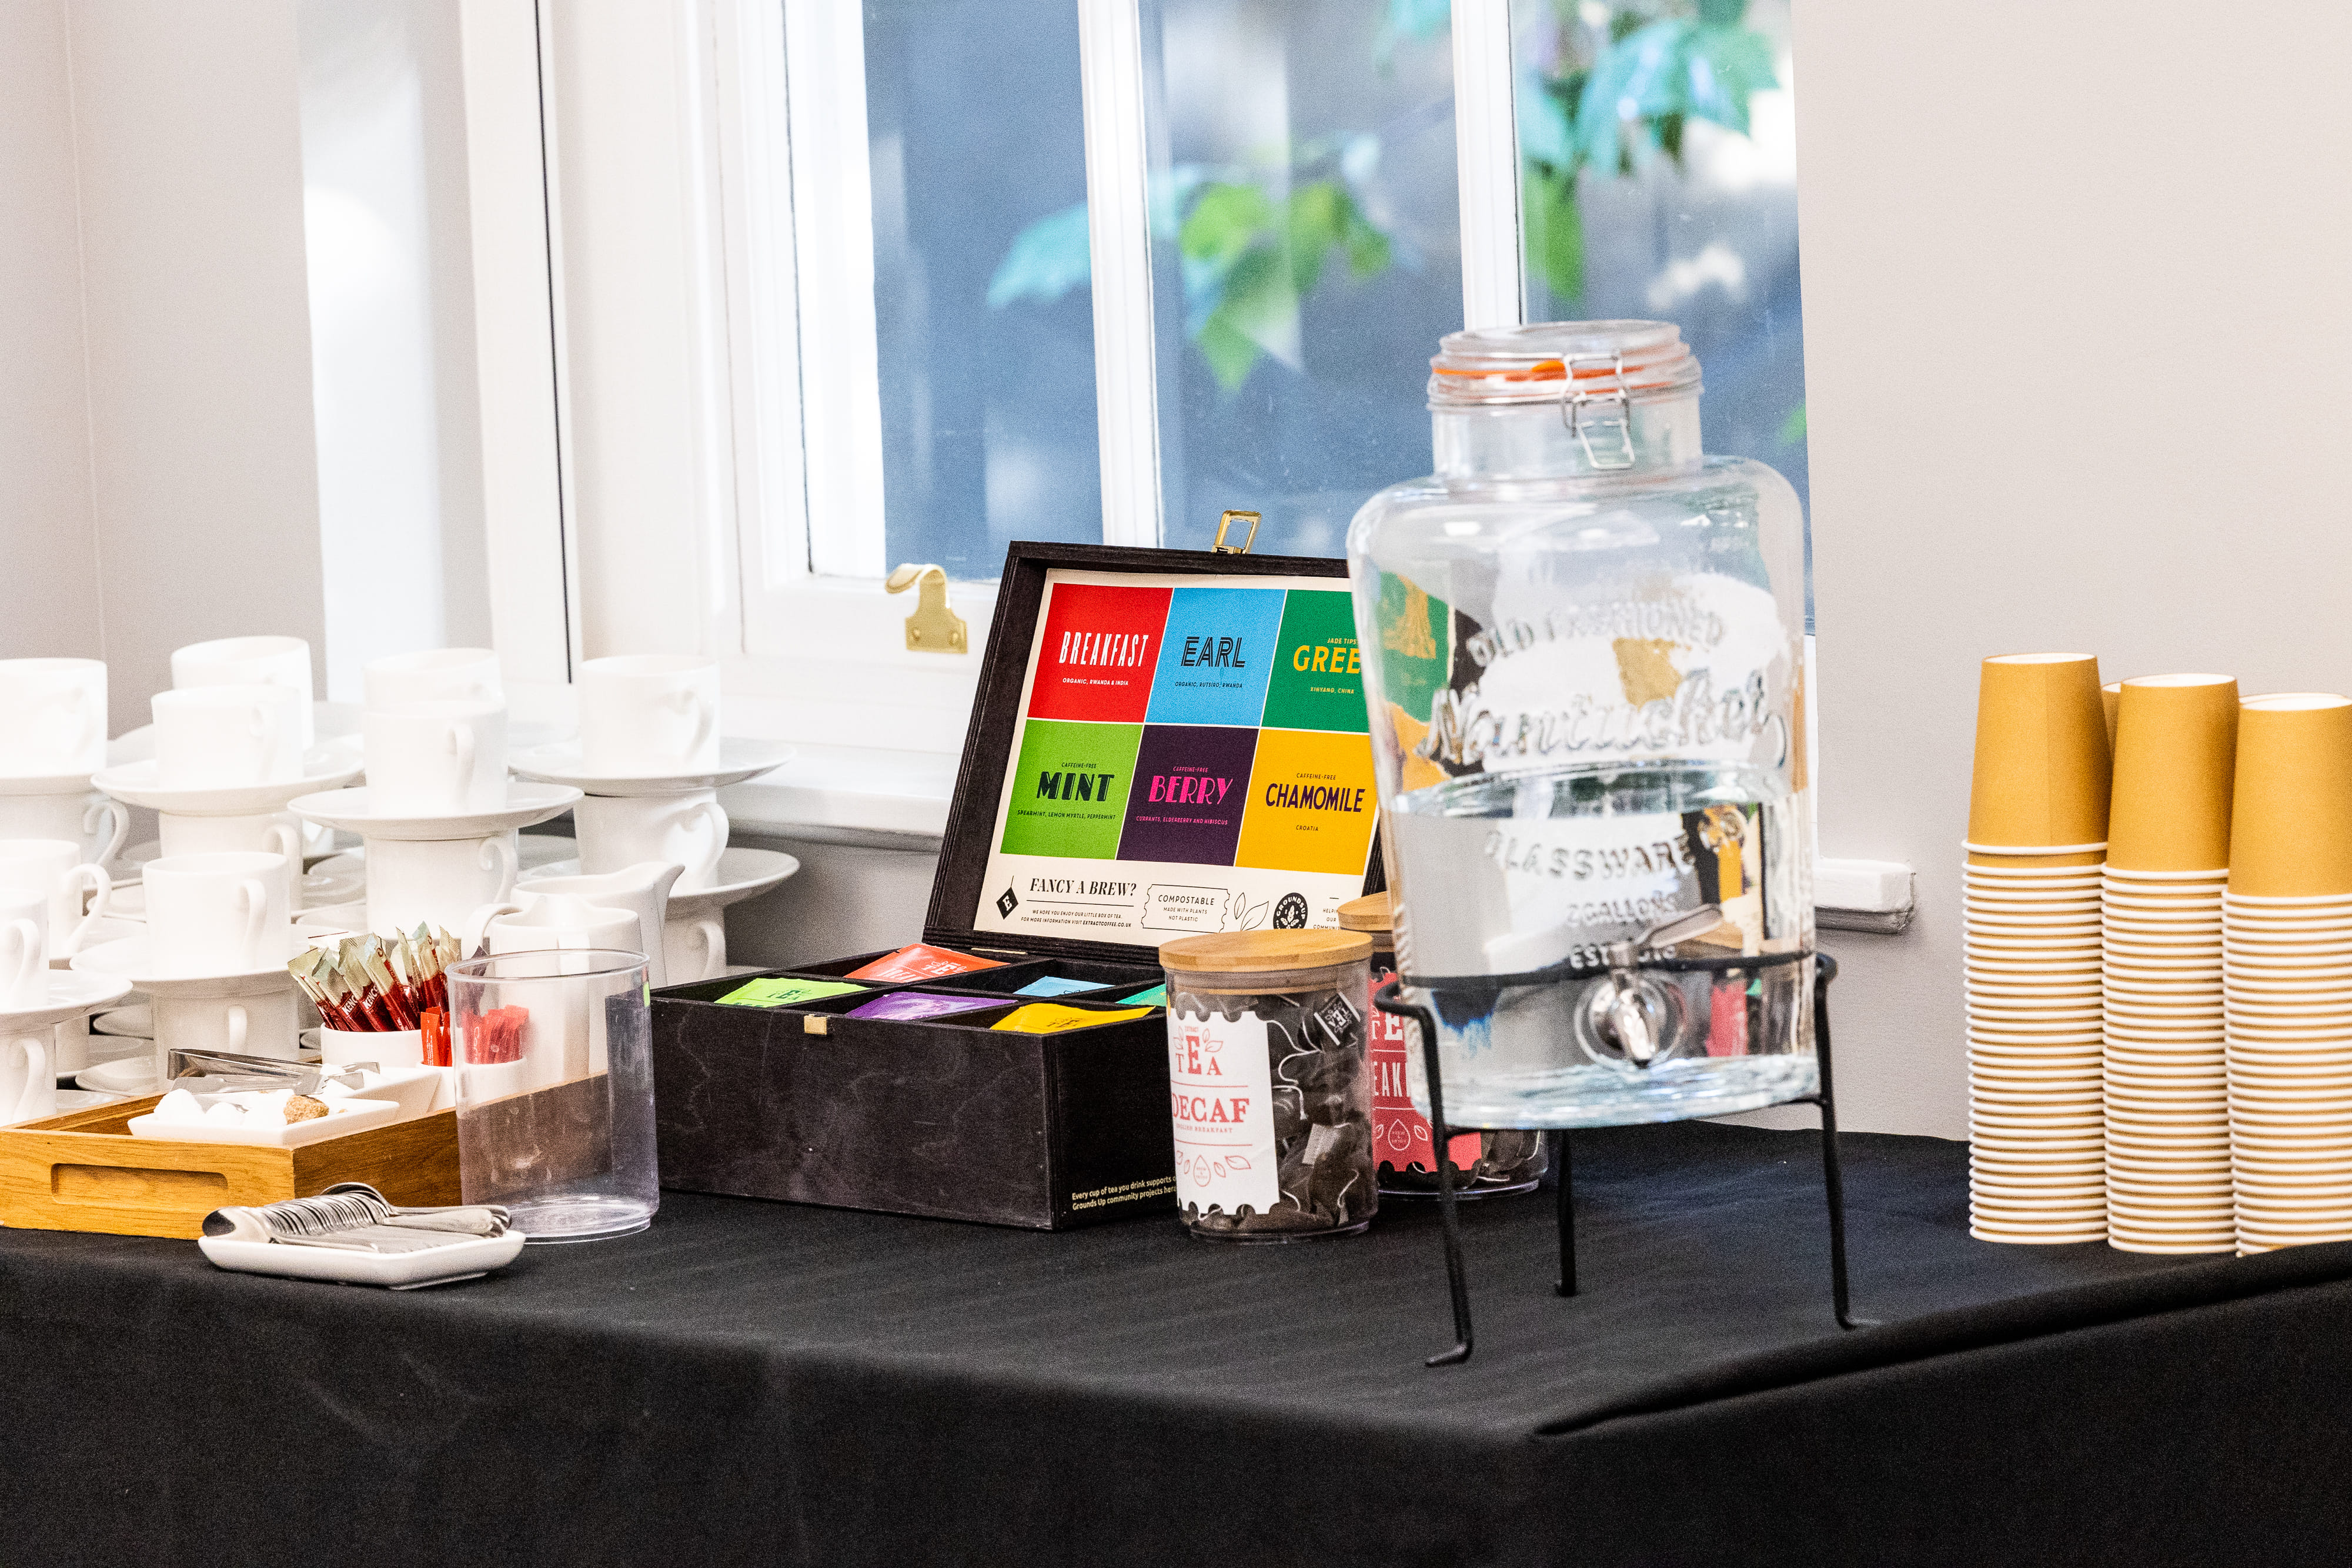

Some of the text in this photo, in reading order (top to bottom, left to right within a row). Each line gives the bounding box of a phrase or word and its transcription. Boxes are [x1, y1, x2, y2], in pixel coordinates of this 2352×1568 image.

[1059, 631, 1149, 667] BREAKFAST
[1181, 637, 1245, 667] EARL
[1294, 645, 1361, 674] GREE
[1037, 771, 1115, 801] MINT
[1148, 775, 1233, 804] BERRY
[1265, 783, 1365, 813] CHAMOMILE
[1486, 830, 1696, 879] GLASSWARE
[1030, 878, 1137, 897] FANCY A BREW?
[1158, 894, 1215, 905] COMPOSTABLE
[342, 995, 358, 1016] KENC
[1175, 1035, 1222, 1075] TEA
[1172, 1092, 1250, 1123] DECAF
[1072, 1192, 1088, 1201] Every
[1089, 1189, 1100, 1198] cup
[1118, 1183, 1130, 1193] you
[1131, 1179, 1145, 1189] drink
[1147, 1176, 1172, 1187] supports
[1073, 1199, 1097, 1211] Grounds
[1098, 1198, 1106, 1207] Up
[1107, 1192, 1139, 1204] community
[1140, 1187, 1163, 1200] projects
